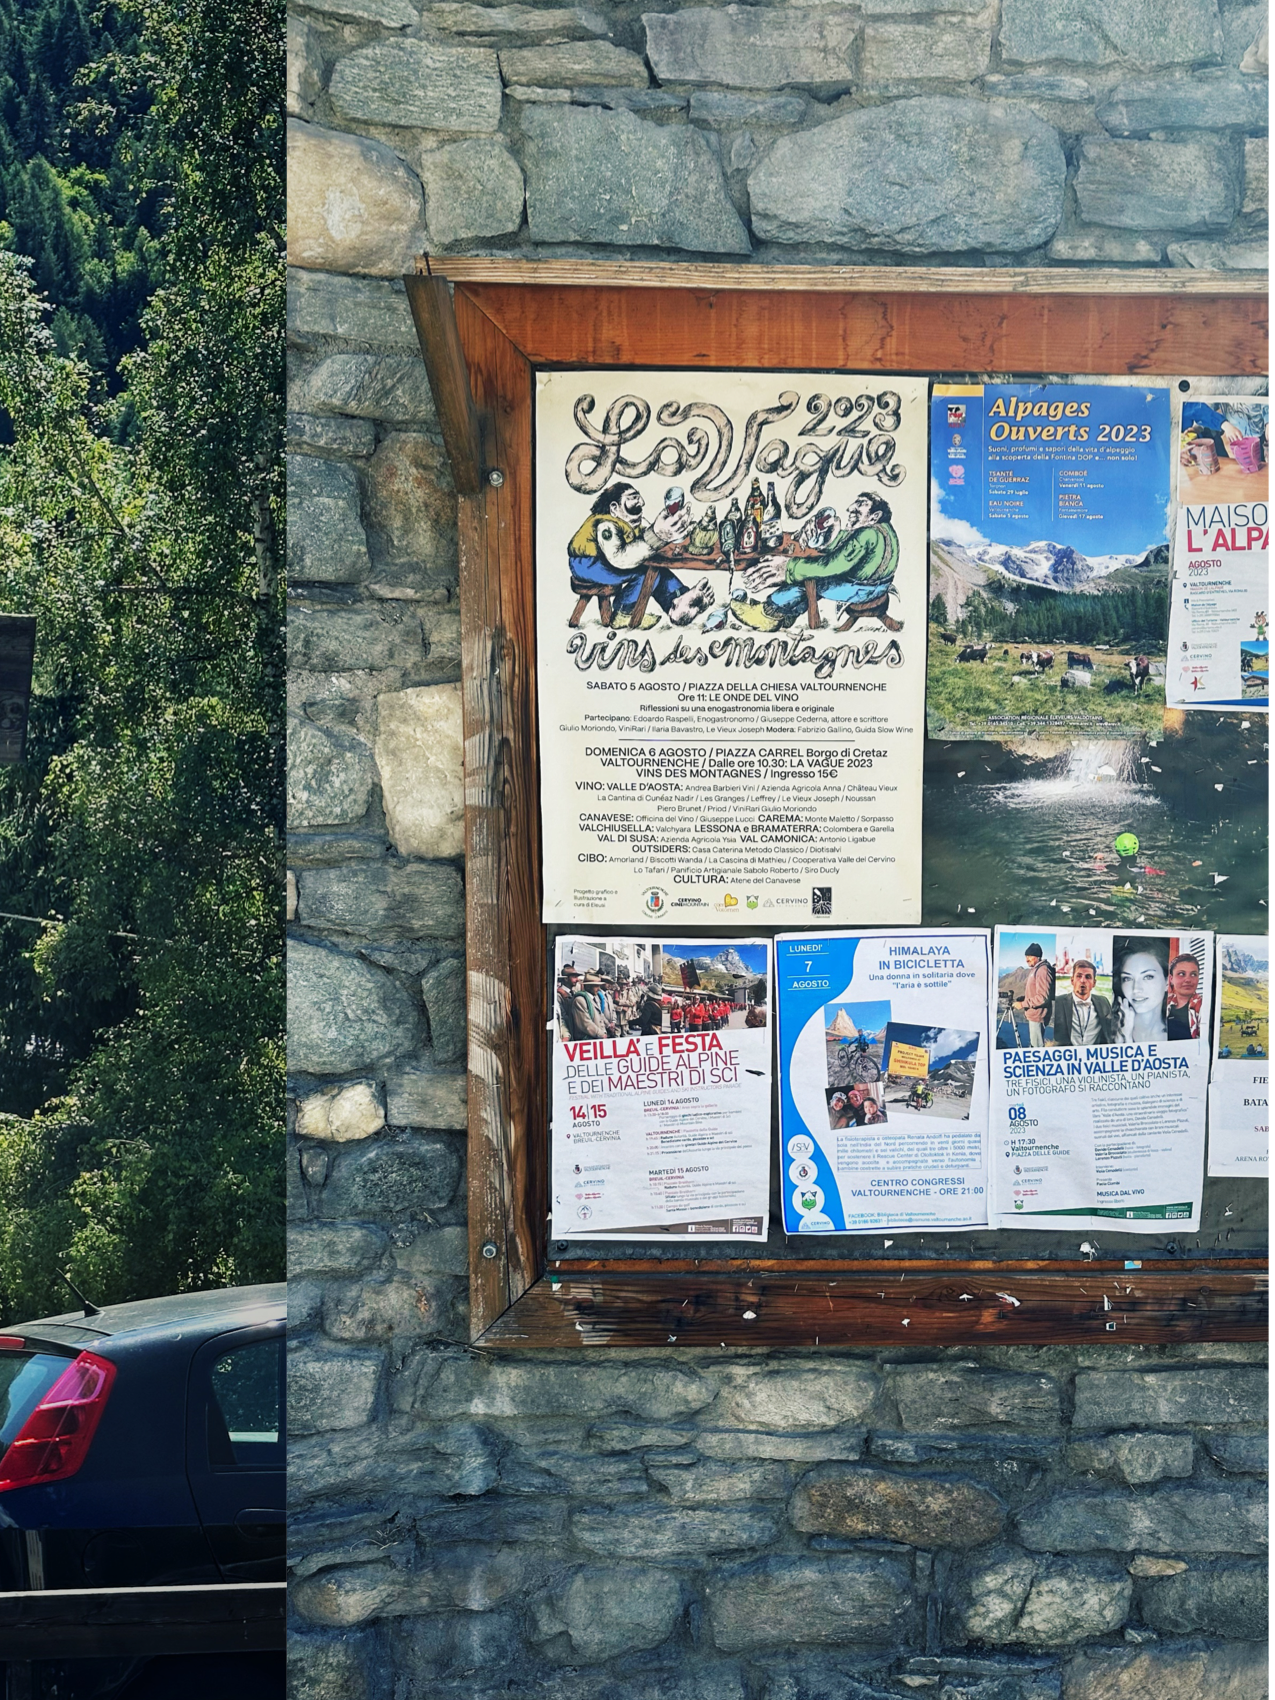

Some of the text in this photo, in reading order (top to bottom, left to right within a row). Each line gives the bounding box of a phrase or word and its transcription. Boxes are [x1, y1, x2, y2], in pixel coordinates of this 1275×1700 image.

[798, 390, 902, 437] 2023
[988, 396, 1091, 422] Alpages
[989, 421, 1153, 442] Ouverts 2023
[565, 390, 907, 520] La Vague
[988, 445, 1009, 453] Suoni,
[1011, 445, 1038, 453] profumi
[1045, 445, 1066, 454] sapori
[1085, 445, 1098, 453] vita
[1100, 445, 1136, 454] d'alpeggio
[1186, 503, 1268, 529] MAISO
[1188, 559, 1222, 569] AGOSTO
[1188, 568, 1209, 577] 2023
[659, 633, 709, 667] des
[586, 680, 886, 691] SABATO 5 AGOSTO PIAZZA DELLA CHIESA VALTOURNENCHE
[677, 693, 799, 702] Ore 11: LE ONDE DEL VINO
[640, 704, 680, 712] Riflessioni
[707, 705, 770, 714] enogastronomia
[801, 705, 834, 714] originale
[585, 747, 888, 760] DOMENICA 6 AGOSTO PIAZZA CARREL Borgo di Cretaz
[600, 758, 699, 768] VALTOURNENCHE
[708, 758, 735, 768] Dalle
[757, 758, 788, 768] 10.30:
[790, 758, 804, 768] LA
[807, 758, 844, 768] VAGUE
[847, 758, 874, 768] 2023
[636, 768, 838, 780] VINS DES MONTAGNES Ingresso 15€
[790, 944, 823, 953] LUNEDI'
[889, 945, 950, 956] HIMALAYA
[804, 961, 813, 973] 7
[879, 959, 965, 970] IN BICICLETTA
[792, 979, 829, 989] AGOSTO
[924, 980, 952, 988] sottile"
[645, 1043, 654, 1056] E
[658, 1032, 724, 1055] FESTA
[1003, 1044, 1158, 1065] PAESAGGI, MUSICA E
[566, 1050, 740, 1078] DELLE GUIDE ALPINE
[1003, 1057, 1189, 1078] SCIENZA IN VALLE D'AOSTA
[568, 1066, 738, 1095] E DEI MAESTRI DI SCI
[1006, 1070, 1190, 1088] TRE FISICI, UNA VIOLINISTA, UN PIANISTA,
[1006, 1080, 1151, 1097] UN FOTOGRAFO SI RACCONTANO
[1008, 1107, 1026, 1120] 08
[572, 1120, 601, 1128] AGOSTO
[1009, 1119, 1038, 1127] AGOSTO
[572, 1130, 620, 1138] VALTOURNENCHE
[574, 1136, 621, 1144] BREUIL-CERVINIA
[911, 1177, 965, 1186] CONGRESSI
[851, 1189, 931, 1197] VALTOURNENCHE
[961, 1187, 984, 1195] 21:00
